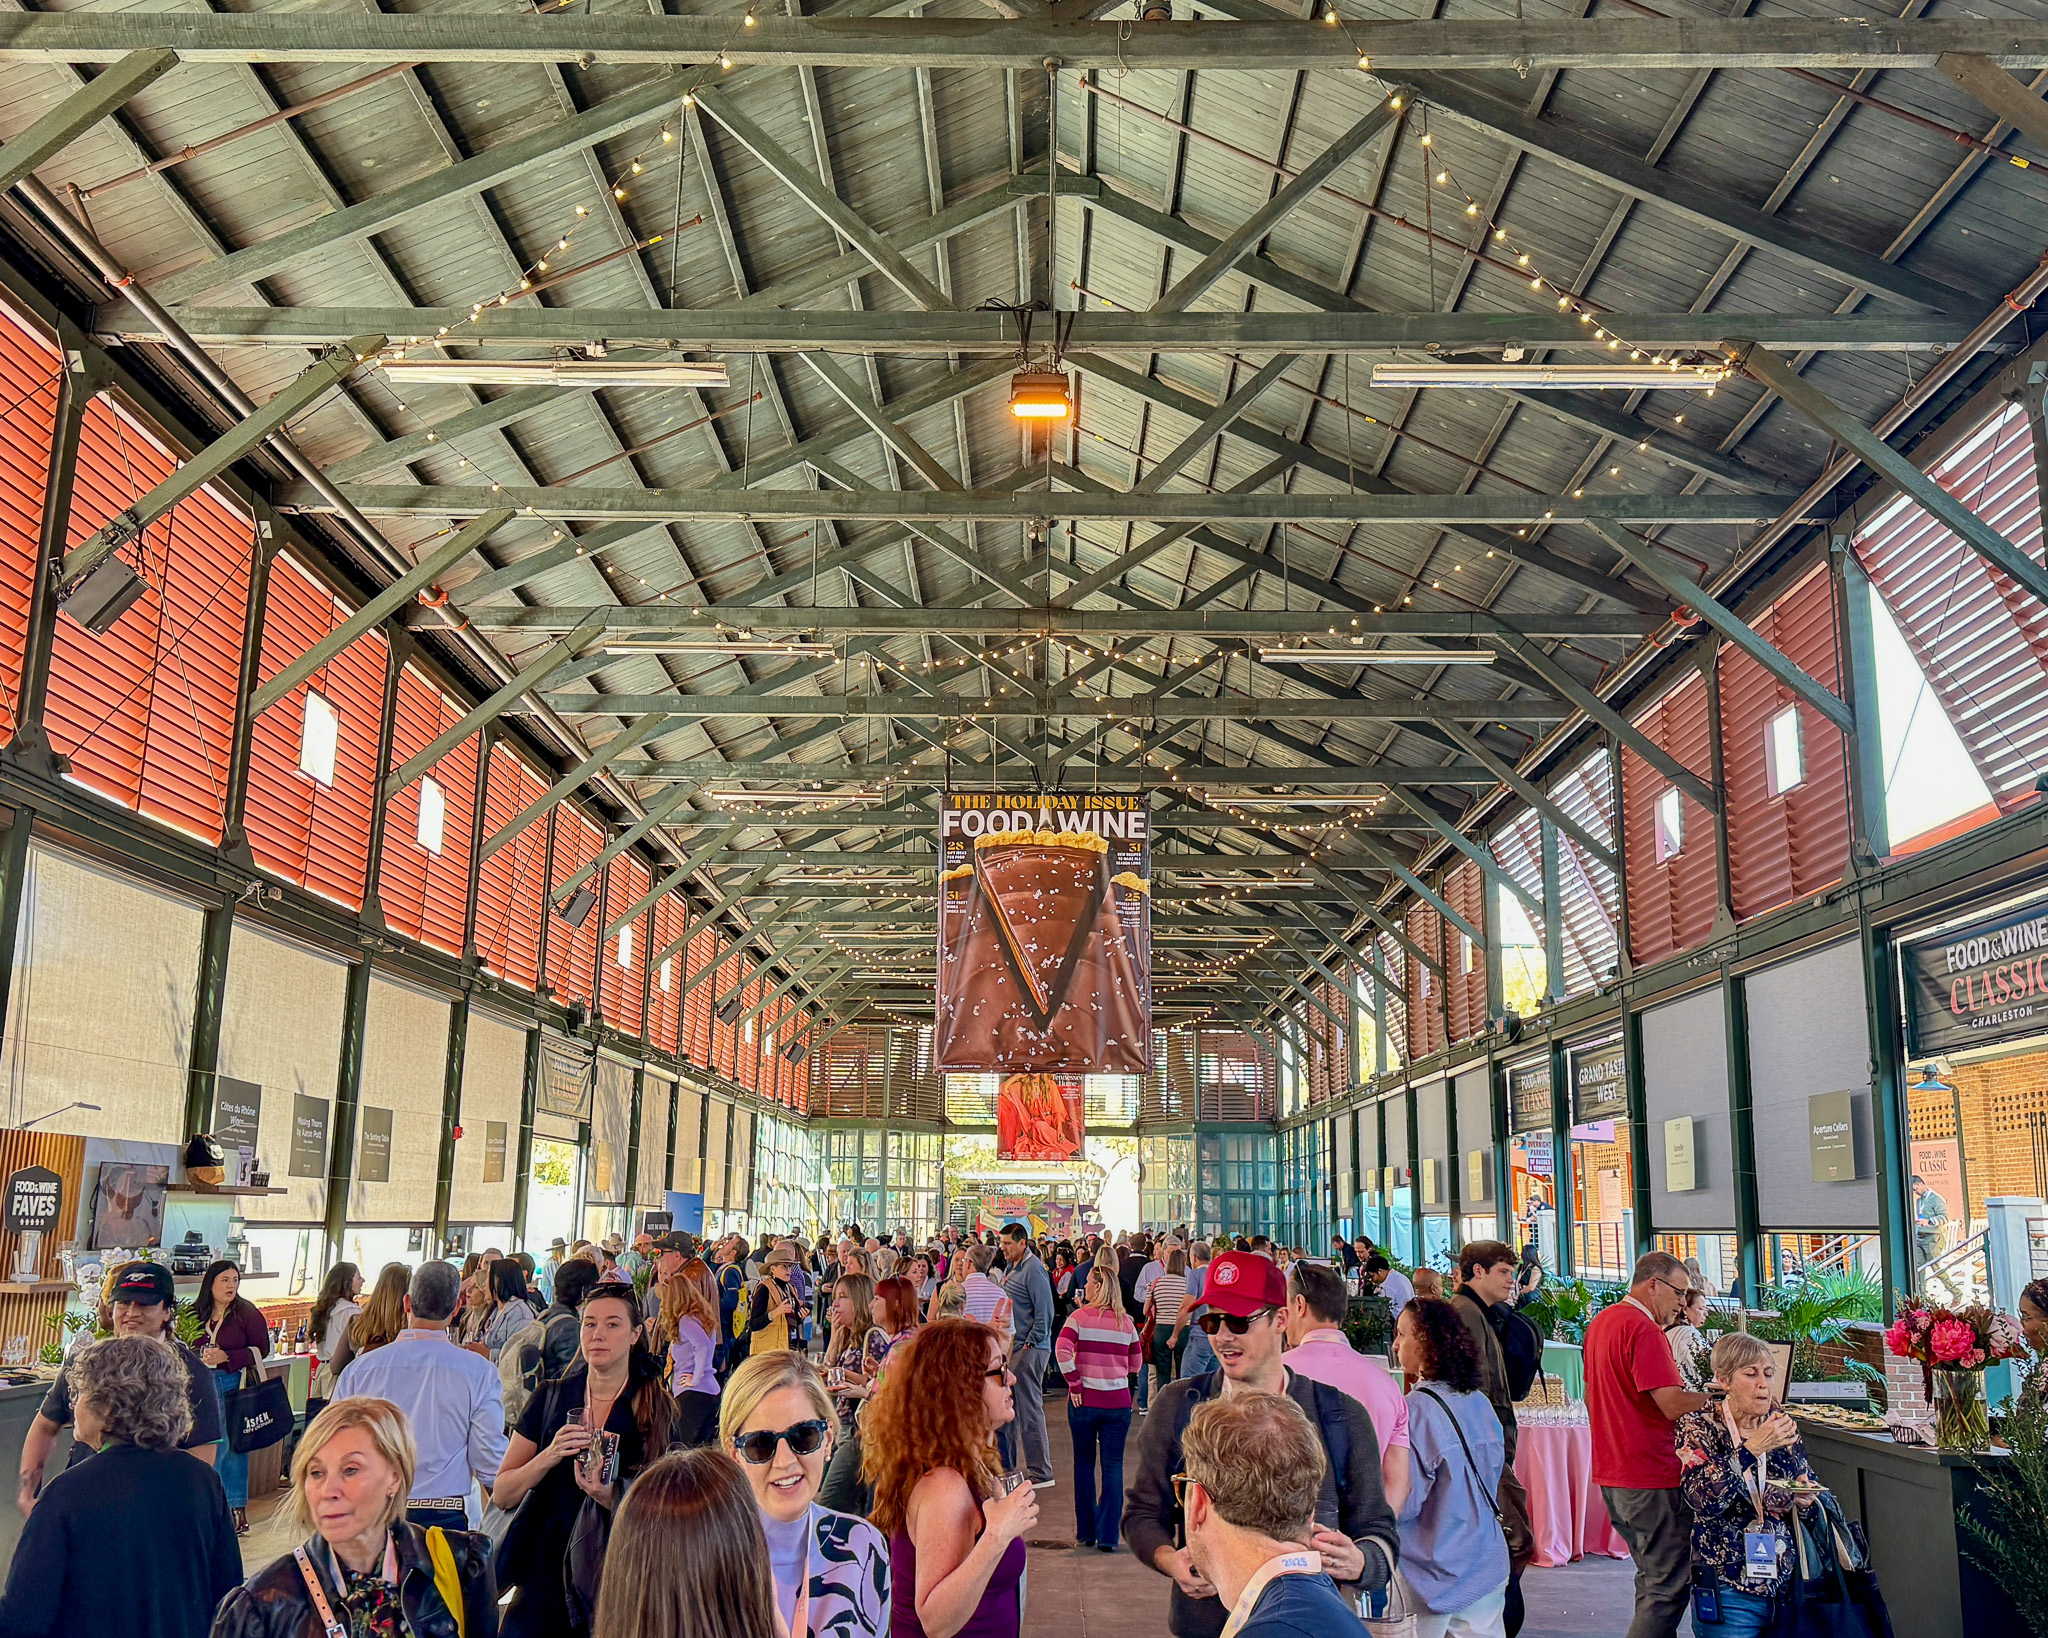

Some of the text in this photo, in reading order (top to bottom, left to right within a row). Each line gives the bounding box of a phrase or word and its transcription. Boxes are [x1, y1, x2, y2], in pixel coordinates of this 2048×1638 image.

[951, 795, 1139, 810] THE HOLIDAY ISSUE
[947, 841, 964, 850] 28
[1128, 843, 1141, 852] 31
[1125, 892, 1141, 901] 25
[1945, 917, 2048, 974] FOOD&WINE
[1950, 953, 2048, 1015] CLASSIC
[1972, 1005, 2033, 1029] CHARLESTON
[1579, 1063, 1604, 1085] GRAND
[1597, 1082, 1618, 1103] WEST
[220, 1101, 235, 1112] Côtes
[234, 1104, 241, 1114] du
[1813, 1121, 1849, 1135] Aperture Cellars
[1530, 1149, 1550, 1157] PARKING
[1919, 1159, 1948, 1173] CLASSIC
[14, 1180, 58, 1194] FOOD&WINE
[11, 1194, 57, 1217] FAVES
[245, 1411, 270, 1429] ASPEN
[1282, 1557, 1308, 1567] 2025
